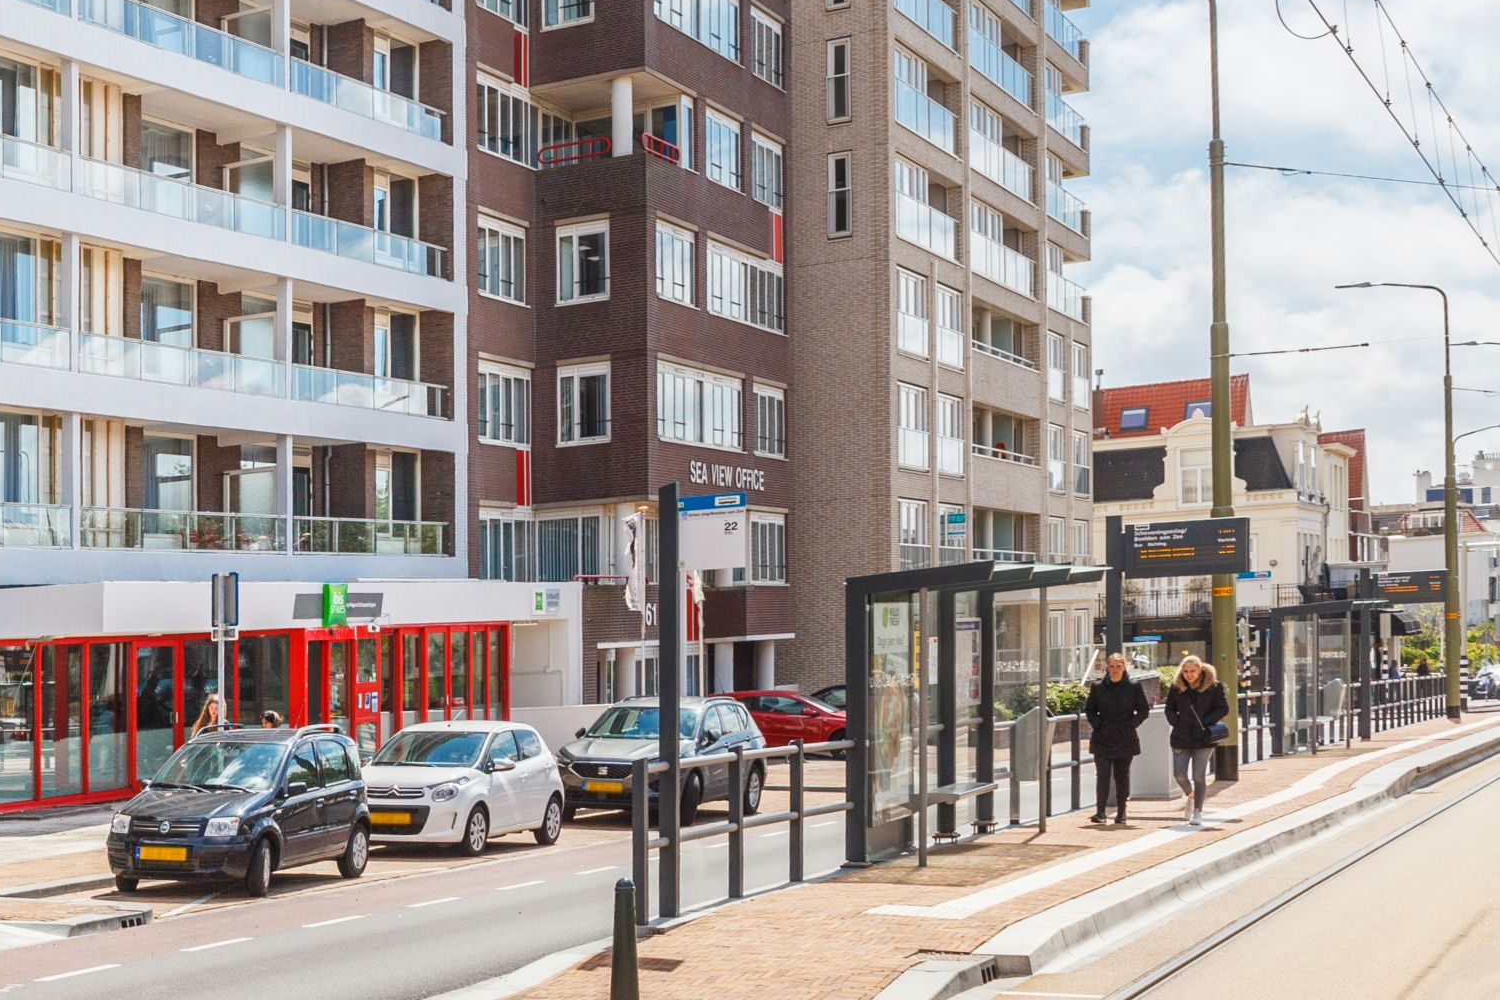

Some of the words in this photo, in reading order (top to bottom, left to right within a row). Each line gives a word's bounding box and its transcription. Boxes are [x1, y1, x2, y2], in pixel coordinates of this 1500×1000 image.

[690, 460, 708, 485] SEA
[711, 464, 733, 488] VIEW
[735, 466, 765, 491] OFFICE
[724, 522, 738, 531] 22
[332, 591, 344, 605] ibis
[645, 602, 657, 626] 61
